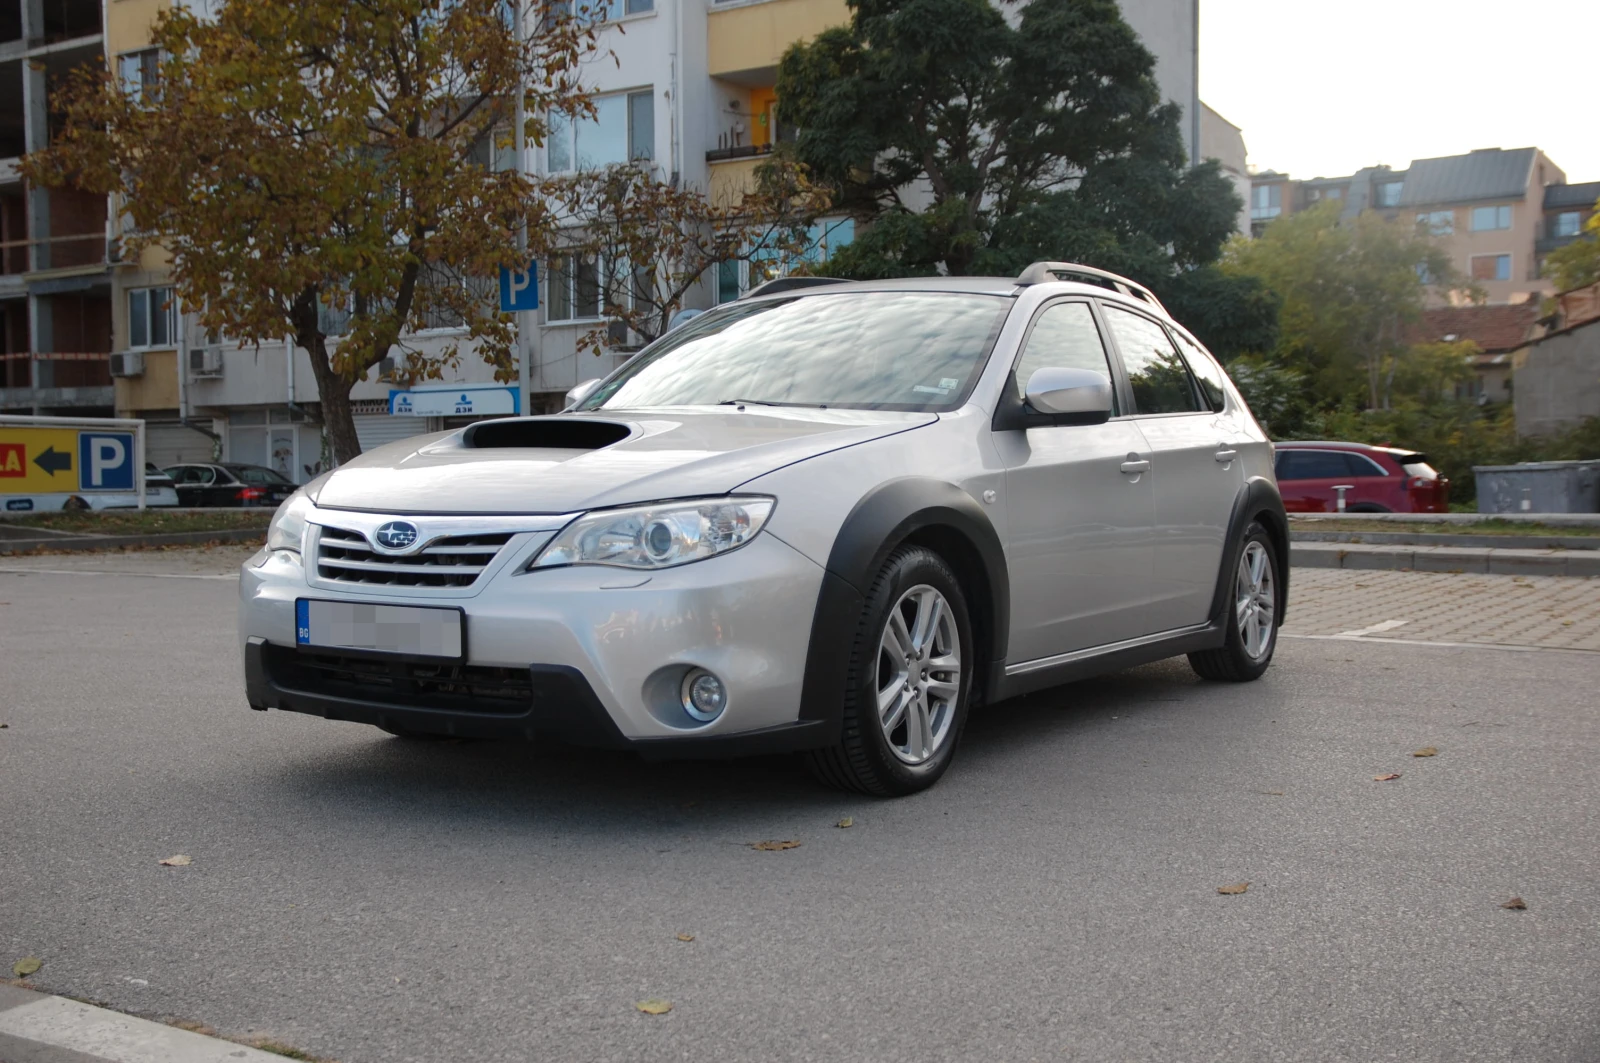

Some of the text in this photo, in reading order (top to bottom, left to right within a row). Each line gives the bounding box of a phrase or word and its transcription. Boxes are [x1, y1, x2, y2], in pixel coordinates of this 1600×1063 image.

[509, 268, 530, 305] P
[0, 450, 22, 471] A
[90, 437, 125, 486] P
[299, 627, 309, 638] BG
